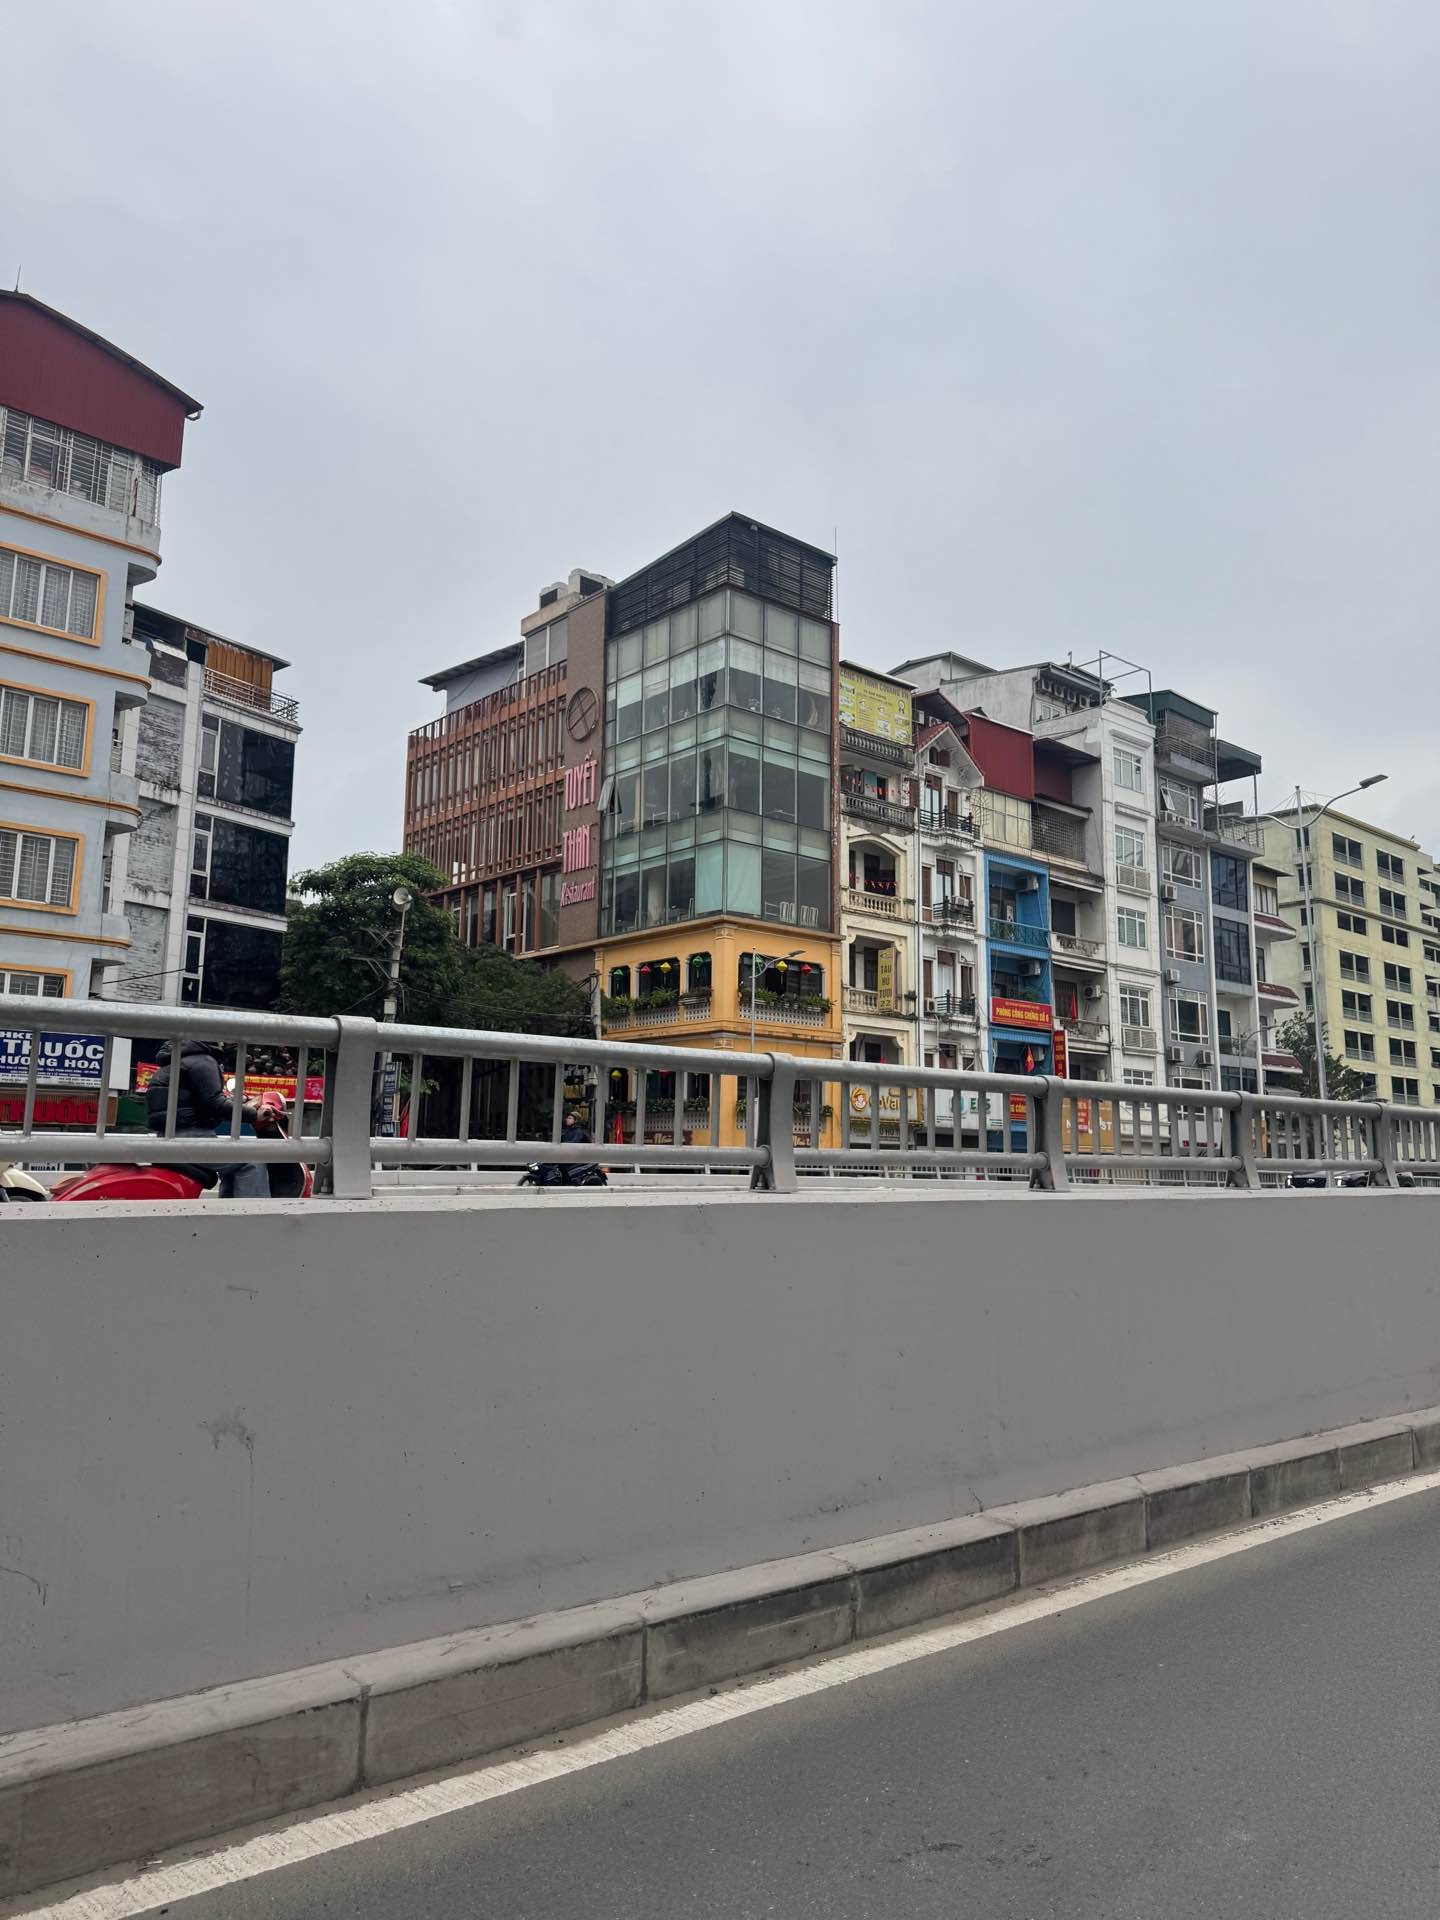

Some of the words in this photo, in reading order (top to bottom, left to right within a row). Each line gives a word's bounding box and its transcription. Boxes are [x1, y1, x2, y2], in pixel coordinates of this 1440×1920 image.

[564, 750, 598, 811] TUYẾT
[560, 875, 595, 908] Restaurant
[880, 1000, 891, 1008] 22
[3, 1039, 104, 1060] THUỐC
[64, 1059, 100, 1069] HOA
